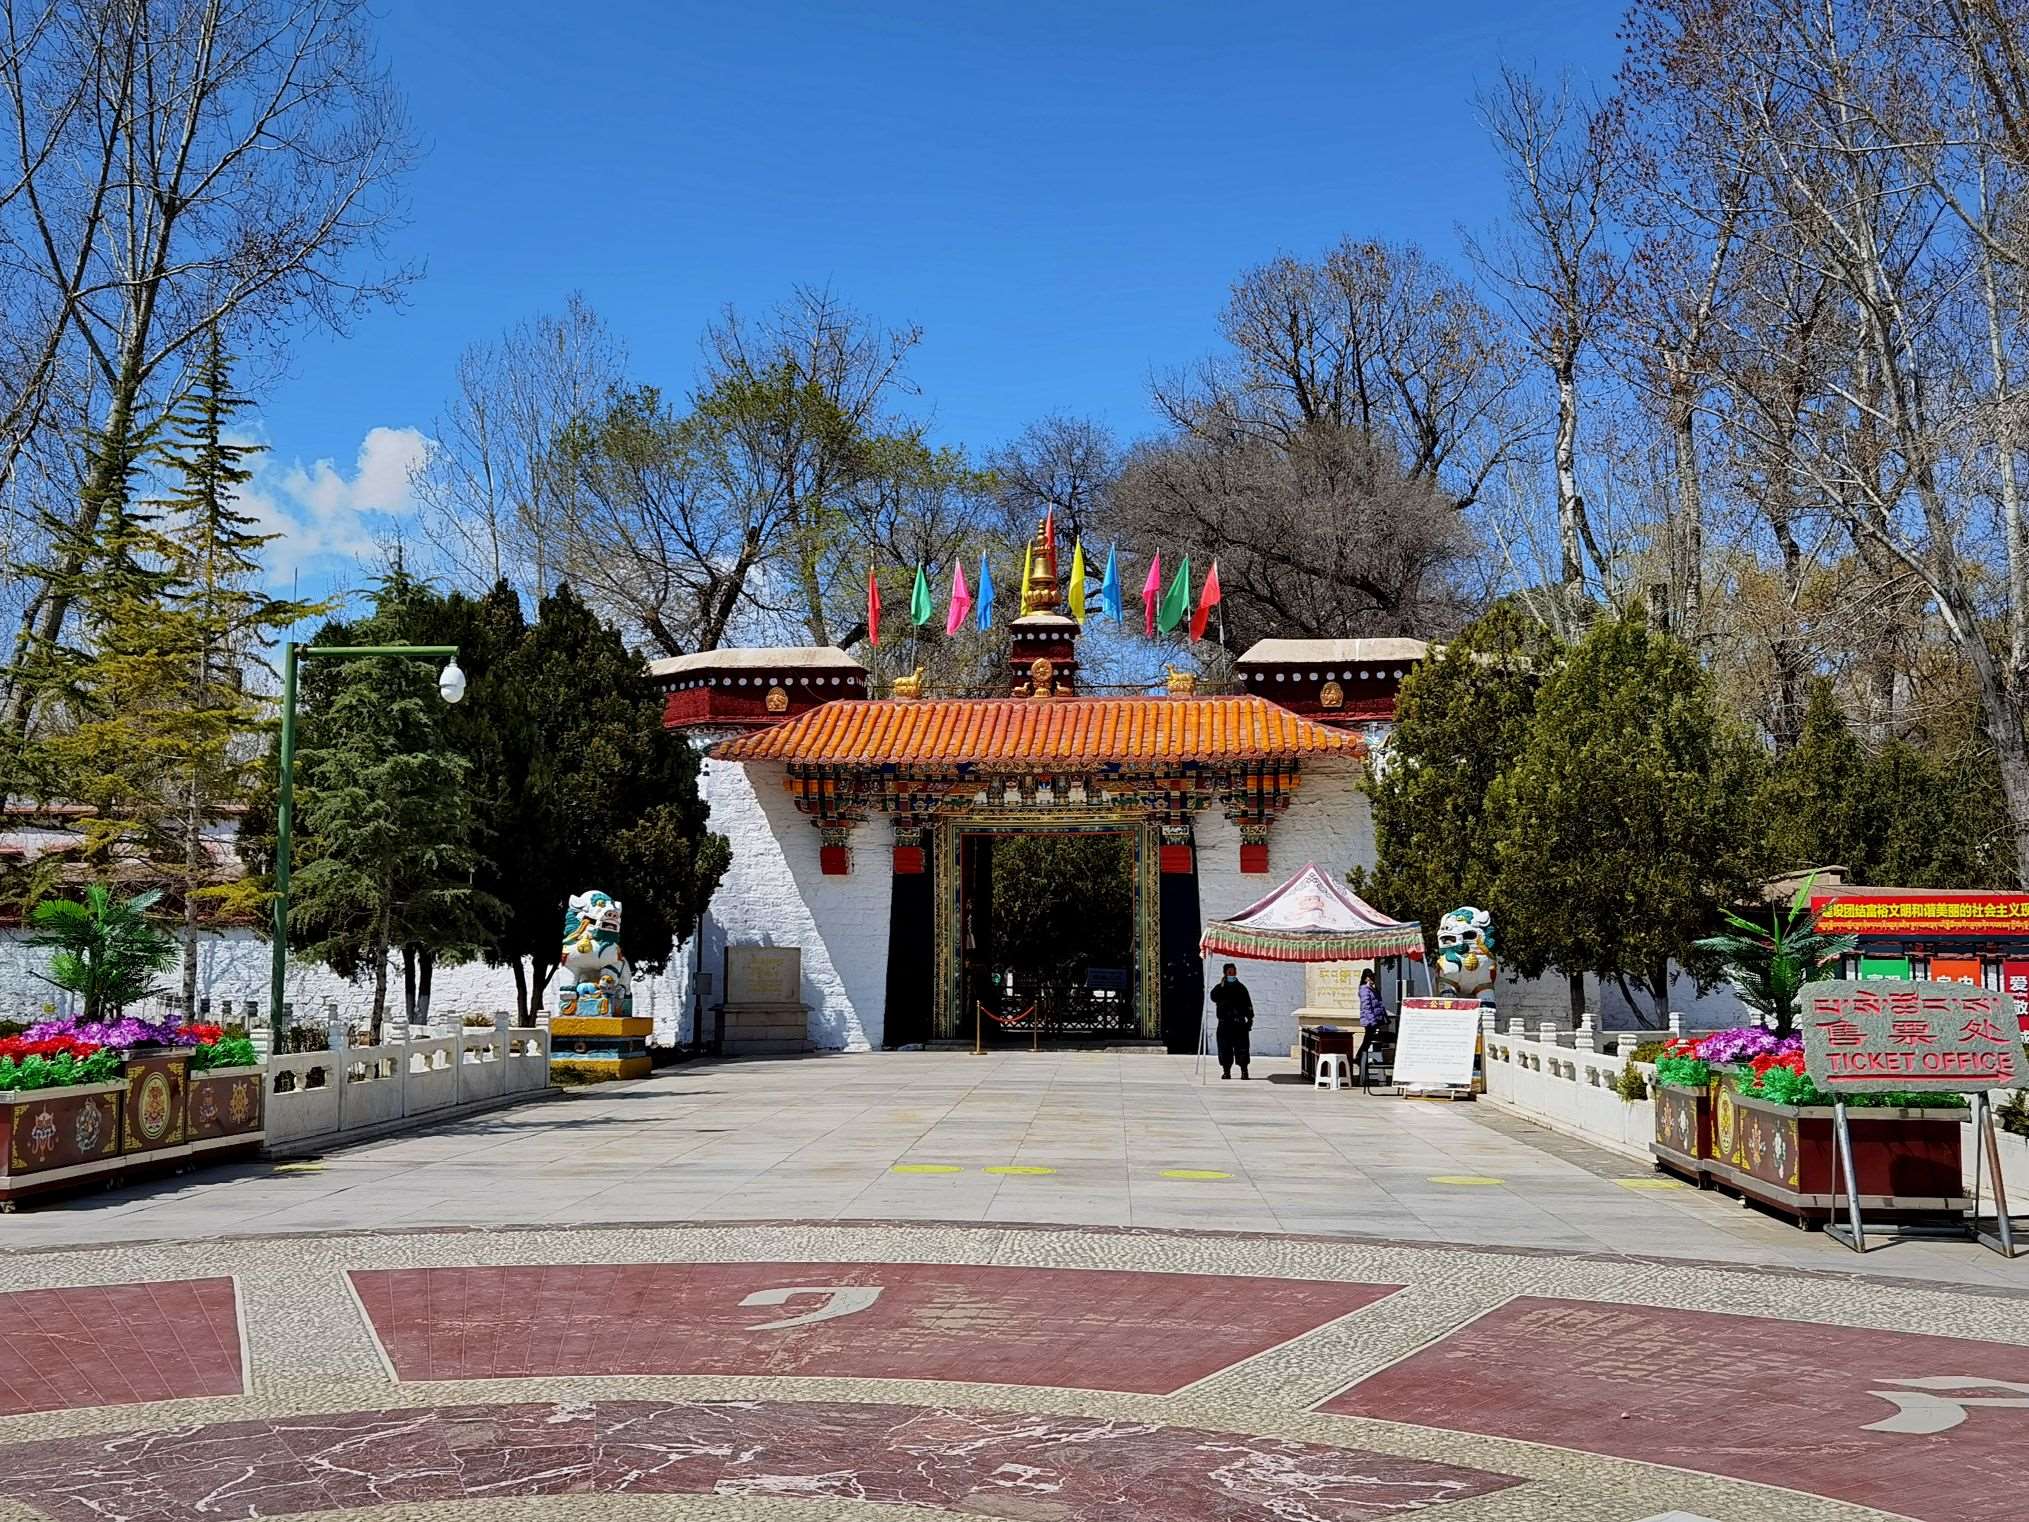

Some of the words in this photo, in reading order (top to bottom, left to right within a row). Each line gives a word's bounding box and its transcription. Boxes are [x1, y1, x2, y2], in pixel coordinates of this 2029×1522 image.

[1814, 1018, 2011, 1047] 售票处
[1825, 1052, 1916, 1072] TICKET
[1922, 1051, 2015, 1072] OFFICE
